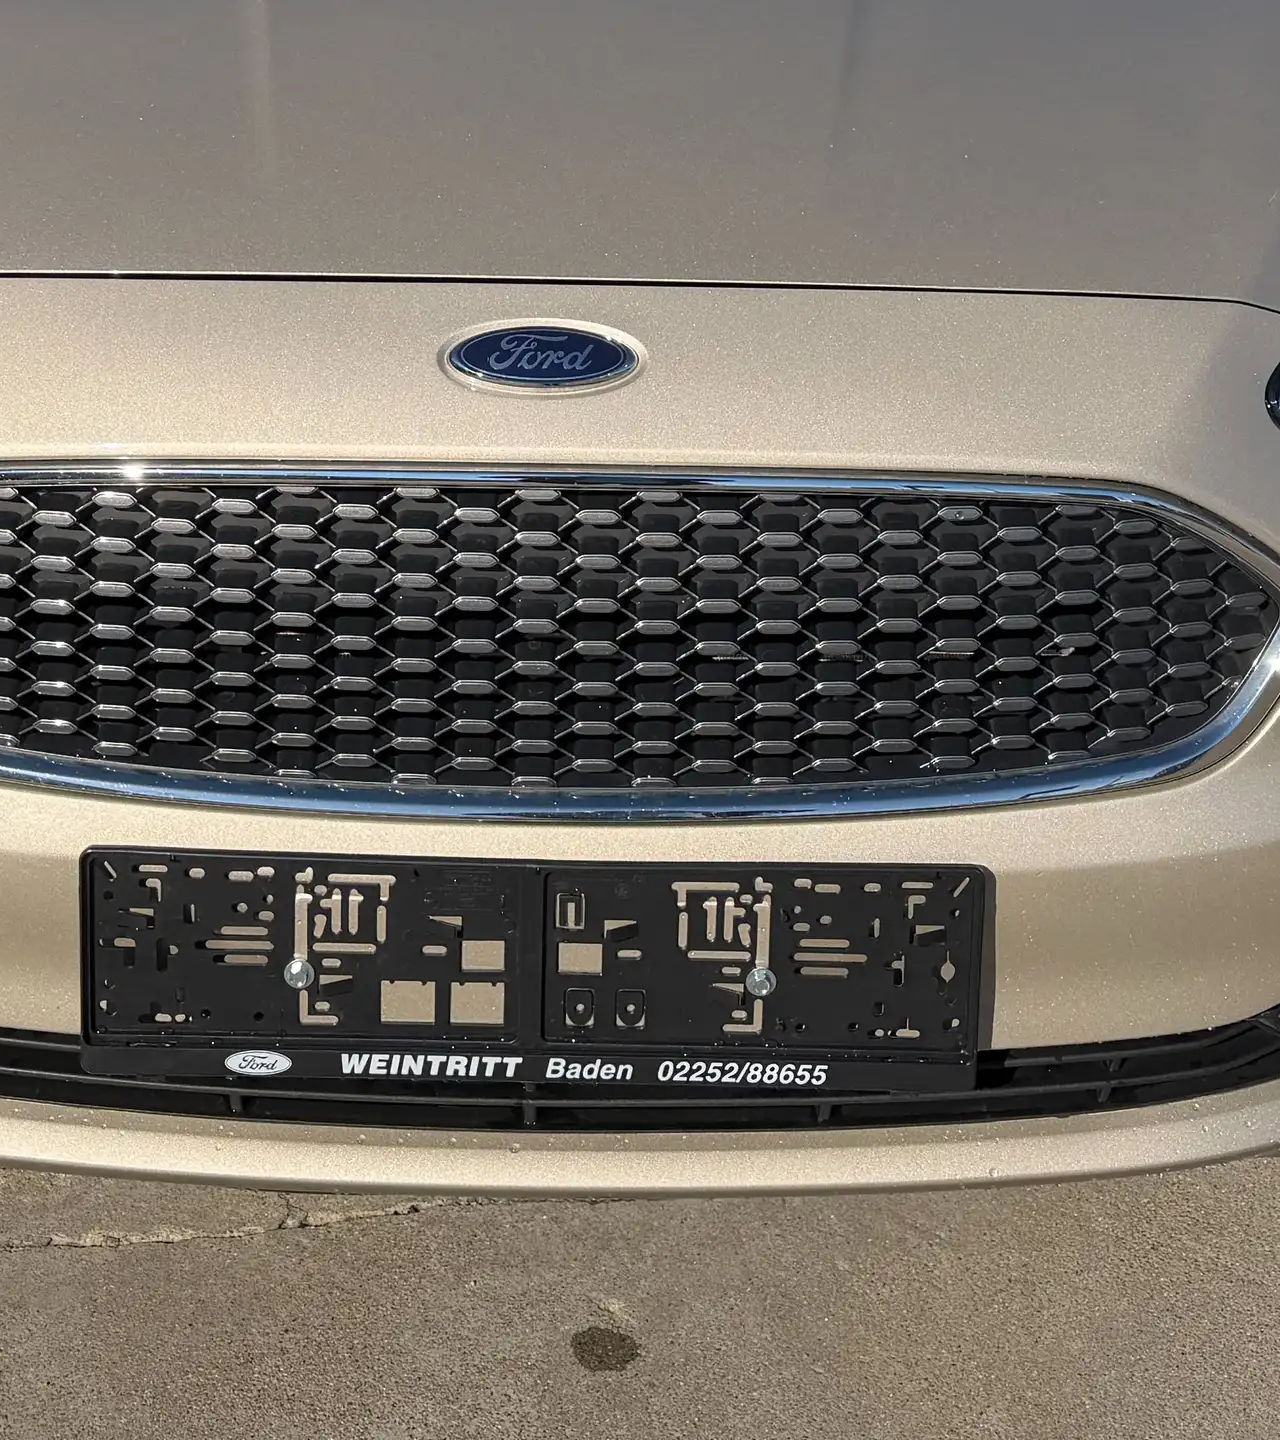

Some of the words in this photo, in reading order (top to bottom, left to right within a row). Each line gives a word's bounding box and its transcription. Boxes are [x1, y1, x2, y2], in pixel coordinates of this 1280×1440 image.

[488, 333, 595, 371] Ford
[237, 1053, 278, 1071] Ford
[340, 1052, 524, 1078] WEINTRITT
[545, 1057, 634, 1081] Baden
[657, 1060, 829, 1086] 02252/88655
